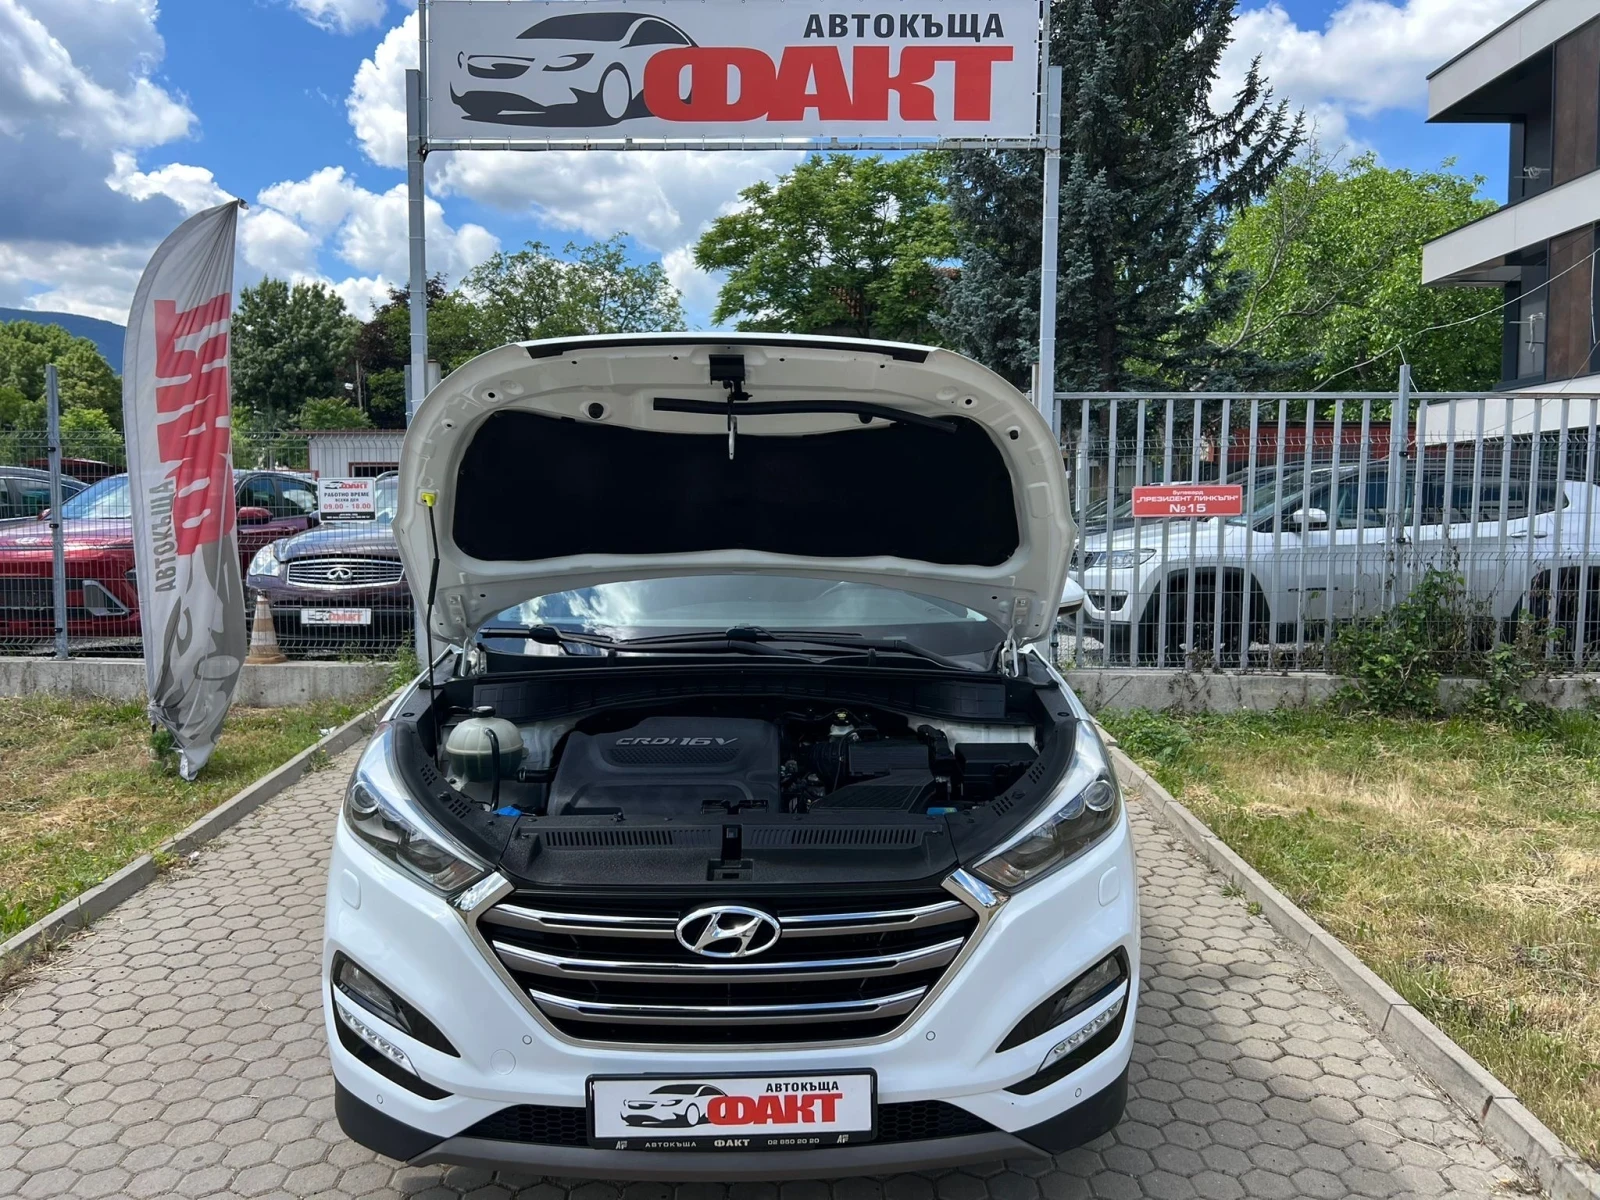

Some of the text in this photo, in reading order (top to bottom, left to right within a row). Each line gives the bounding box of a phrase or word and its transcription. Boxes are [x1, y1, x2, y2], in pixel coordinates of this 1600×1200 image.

[803, 13, 1005, 42] АВТОКЪЩА
[643, 45, 1014, 122] ФАКТ
[153, 291, 236, 556] ФАКТ
[148, 477, 177, 593] АВТОКЪЩА
[765, 1080, 840, 1093] АВТОКЪЩА
[706, 1093, 844, 1126] ФАКТ
[713, 1138, 751, 1148] ФАКТ
